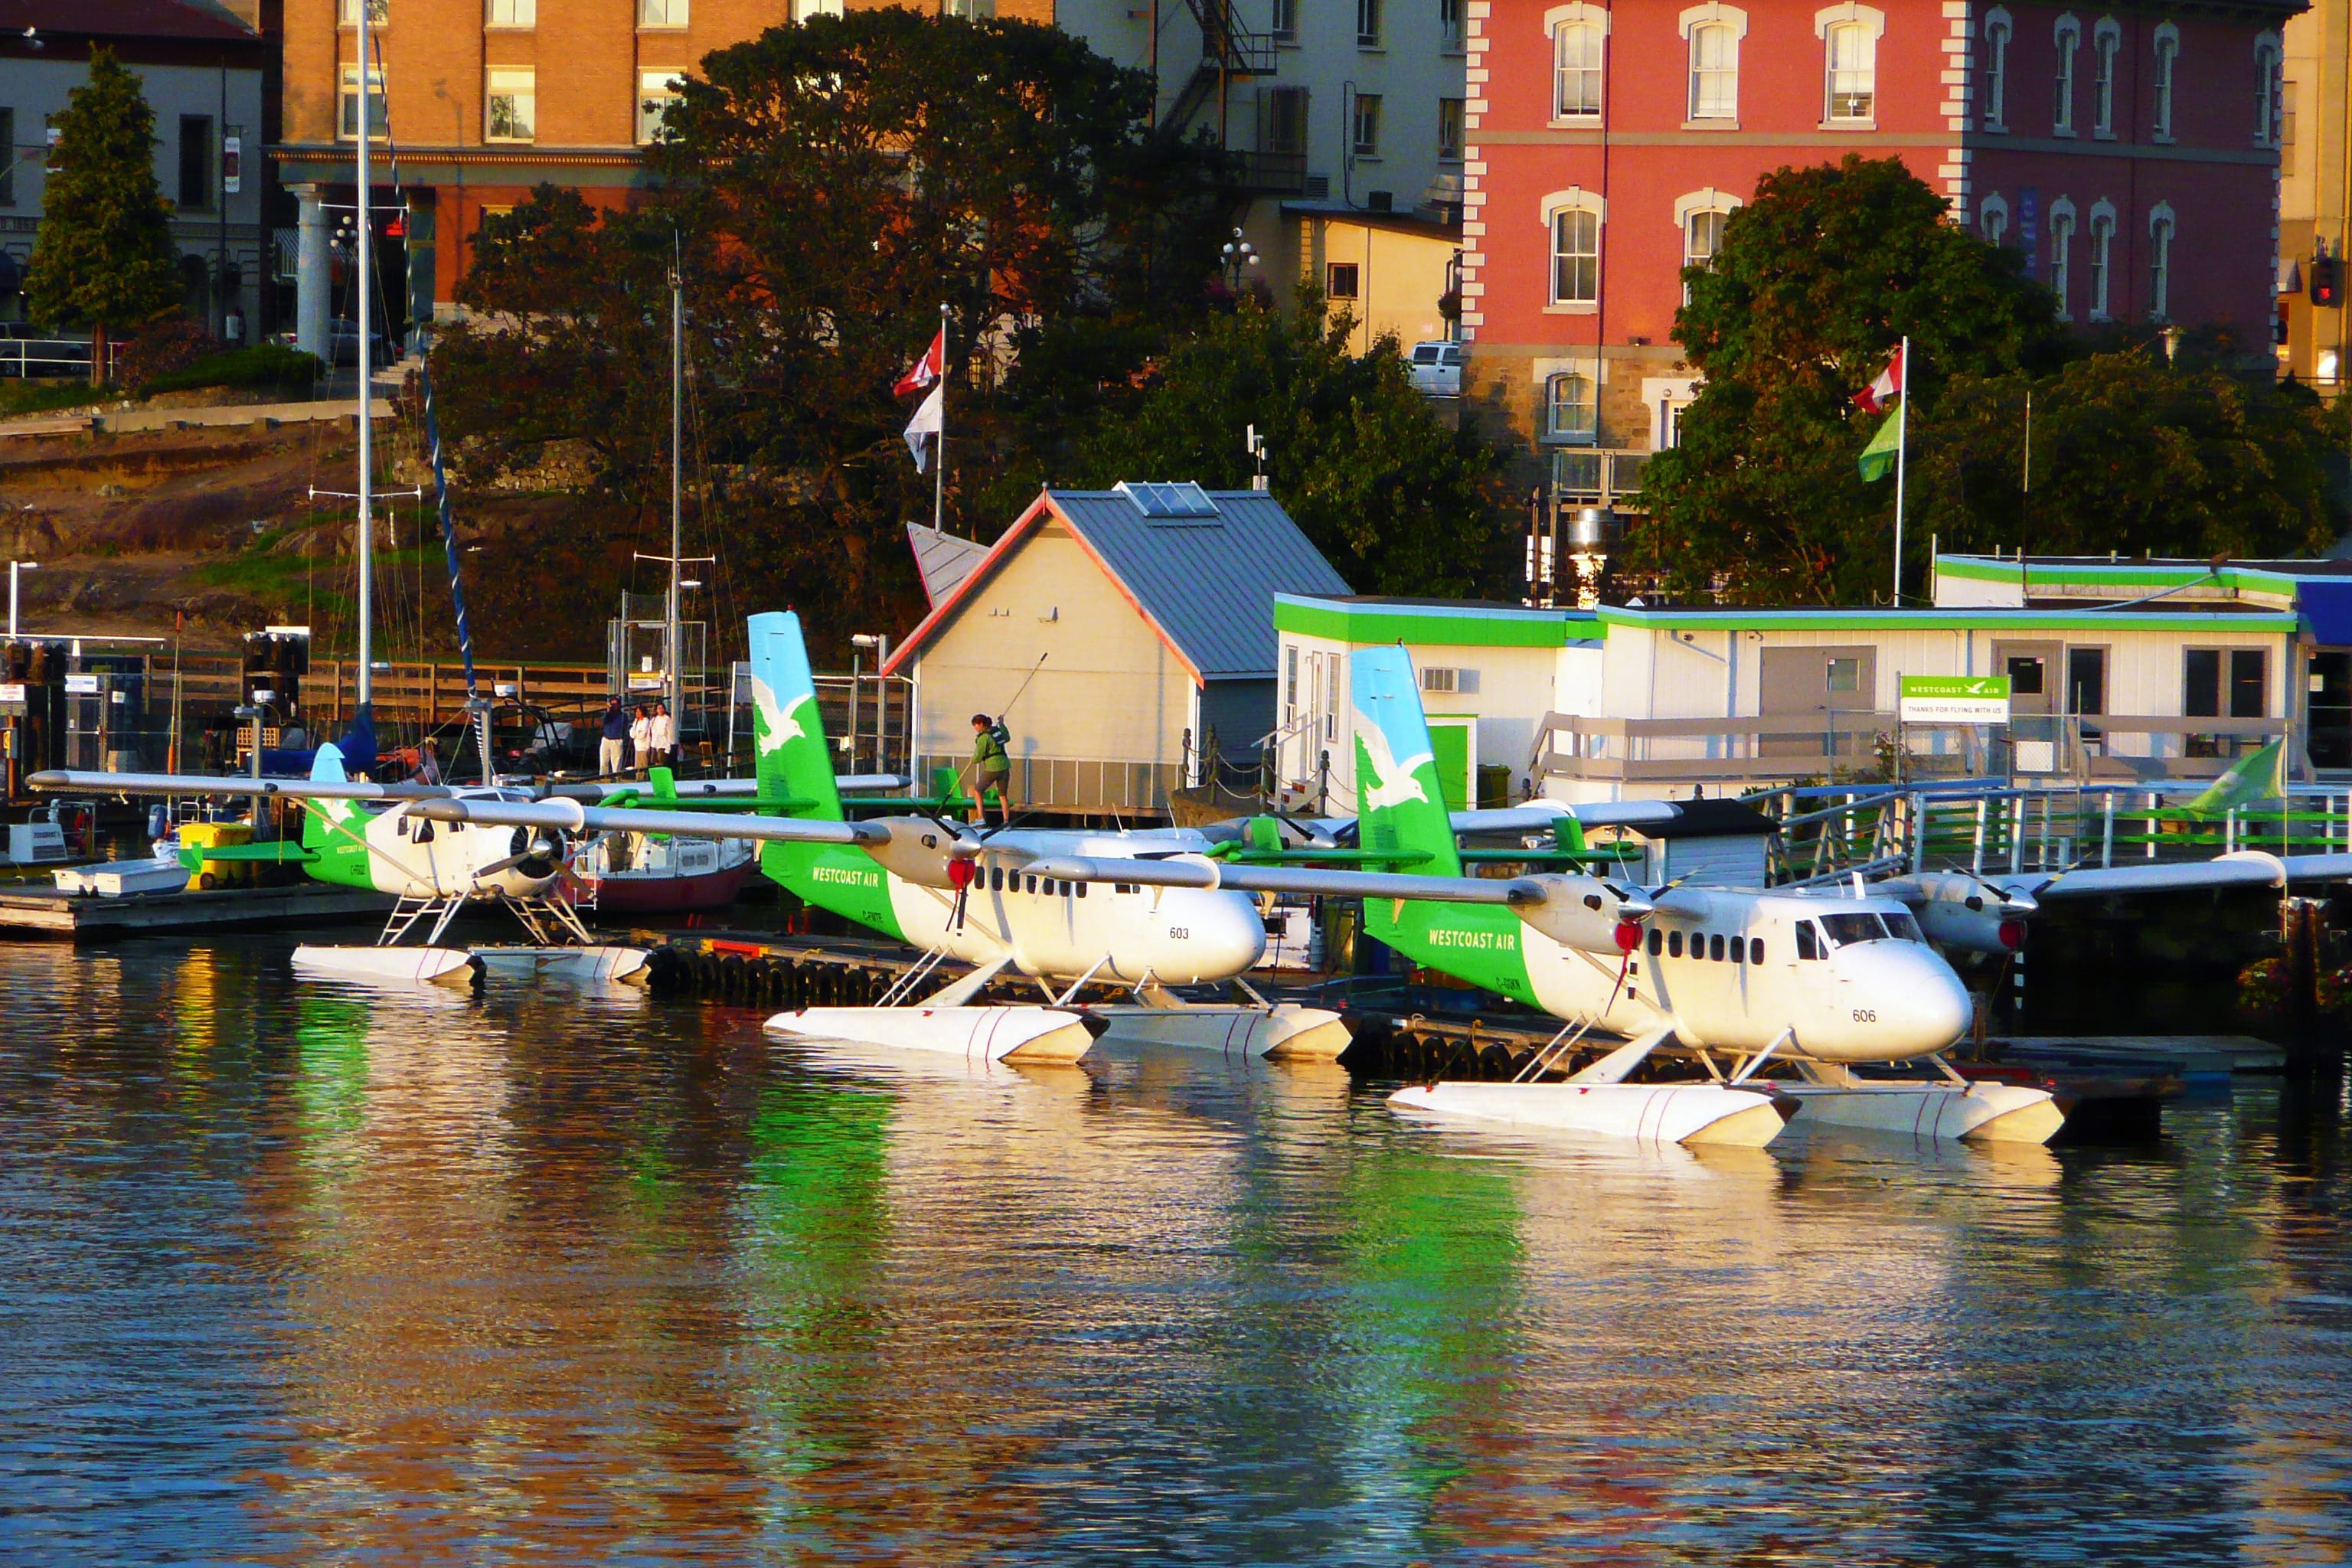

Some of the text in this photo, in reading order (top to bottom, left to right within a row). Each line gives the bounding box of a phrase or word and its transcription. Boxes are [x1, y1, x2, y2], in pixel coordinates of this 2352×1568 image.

[812, 866, 879, 888] WESTCOAST AIR
[1170, 926, 1189, 939] 603
[1429, 929, 1515, 951] WESTCOAST AIR
[1852, 1008, 1877, 1023] 606
